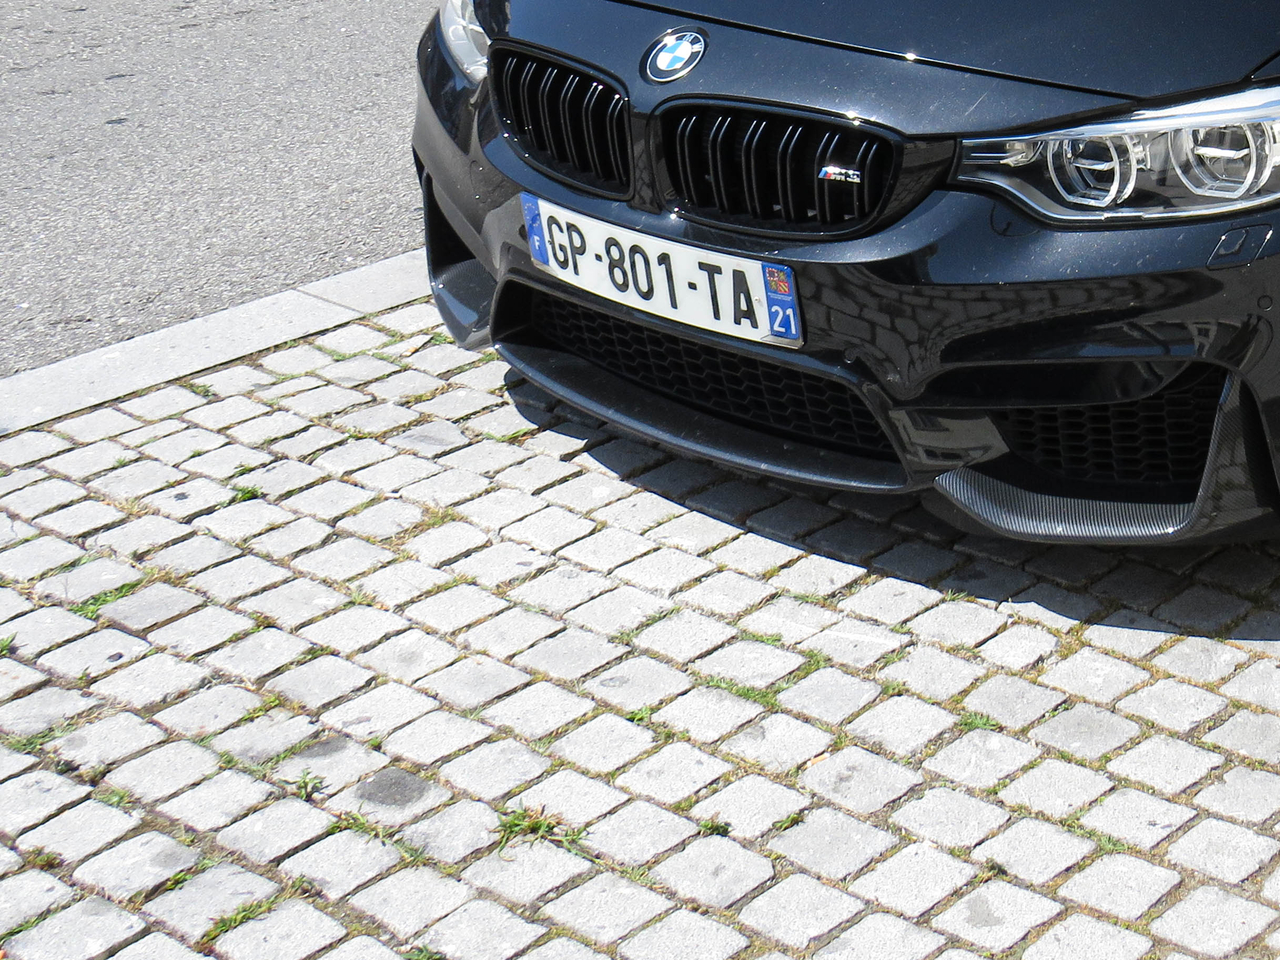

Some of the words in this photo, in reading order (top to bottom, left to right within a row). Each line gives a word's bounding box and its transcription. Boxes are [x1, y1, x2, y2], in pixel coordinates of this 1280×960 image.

[533, 235, 540, 250] F
[547, 215, 759, 329] GP-801-TA
[771, 305, 796, 335] 21
